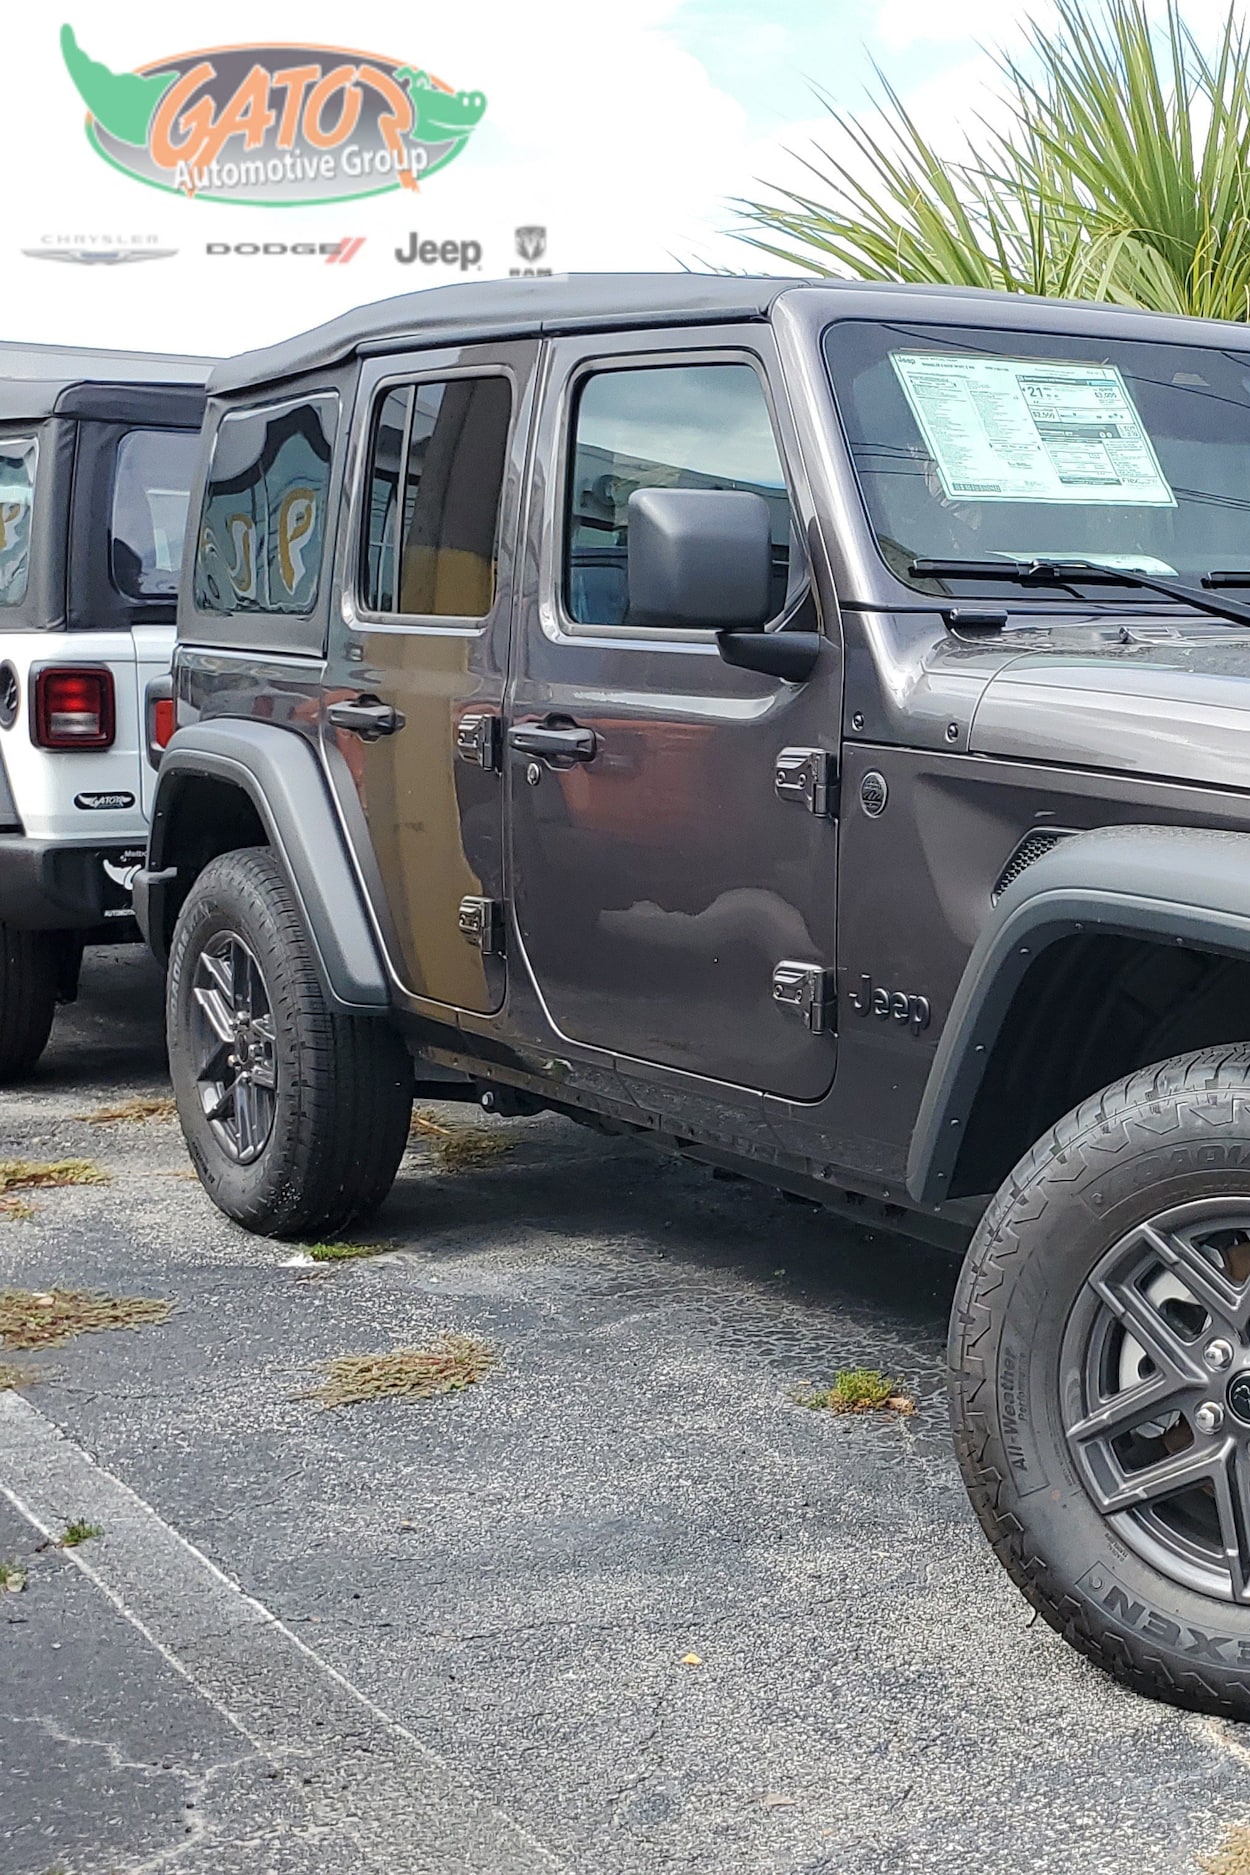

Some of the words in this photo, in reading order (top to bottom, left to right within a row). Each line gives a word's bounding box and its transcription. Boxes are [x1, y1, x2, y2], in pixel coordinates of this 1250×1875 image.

[1027, 386, 1044, 398] 21
[848, 973, 931, 1037] Jeep
[1000, 1347, 1028, 1472] All-Weather
